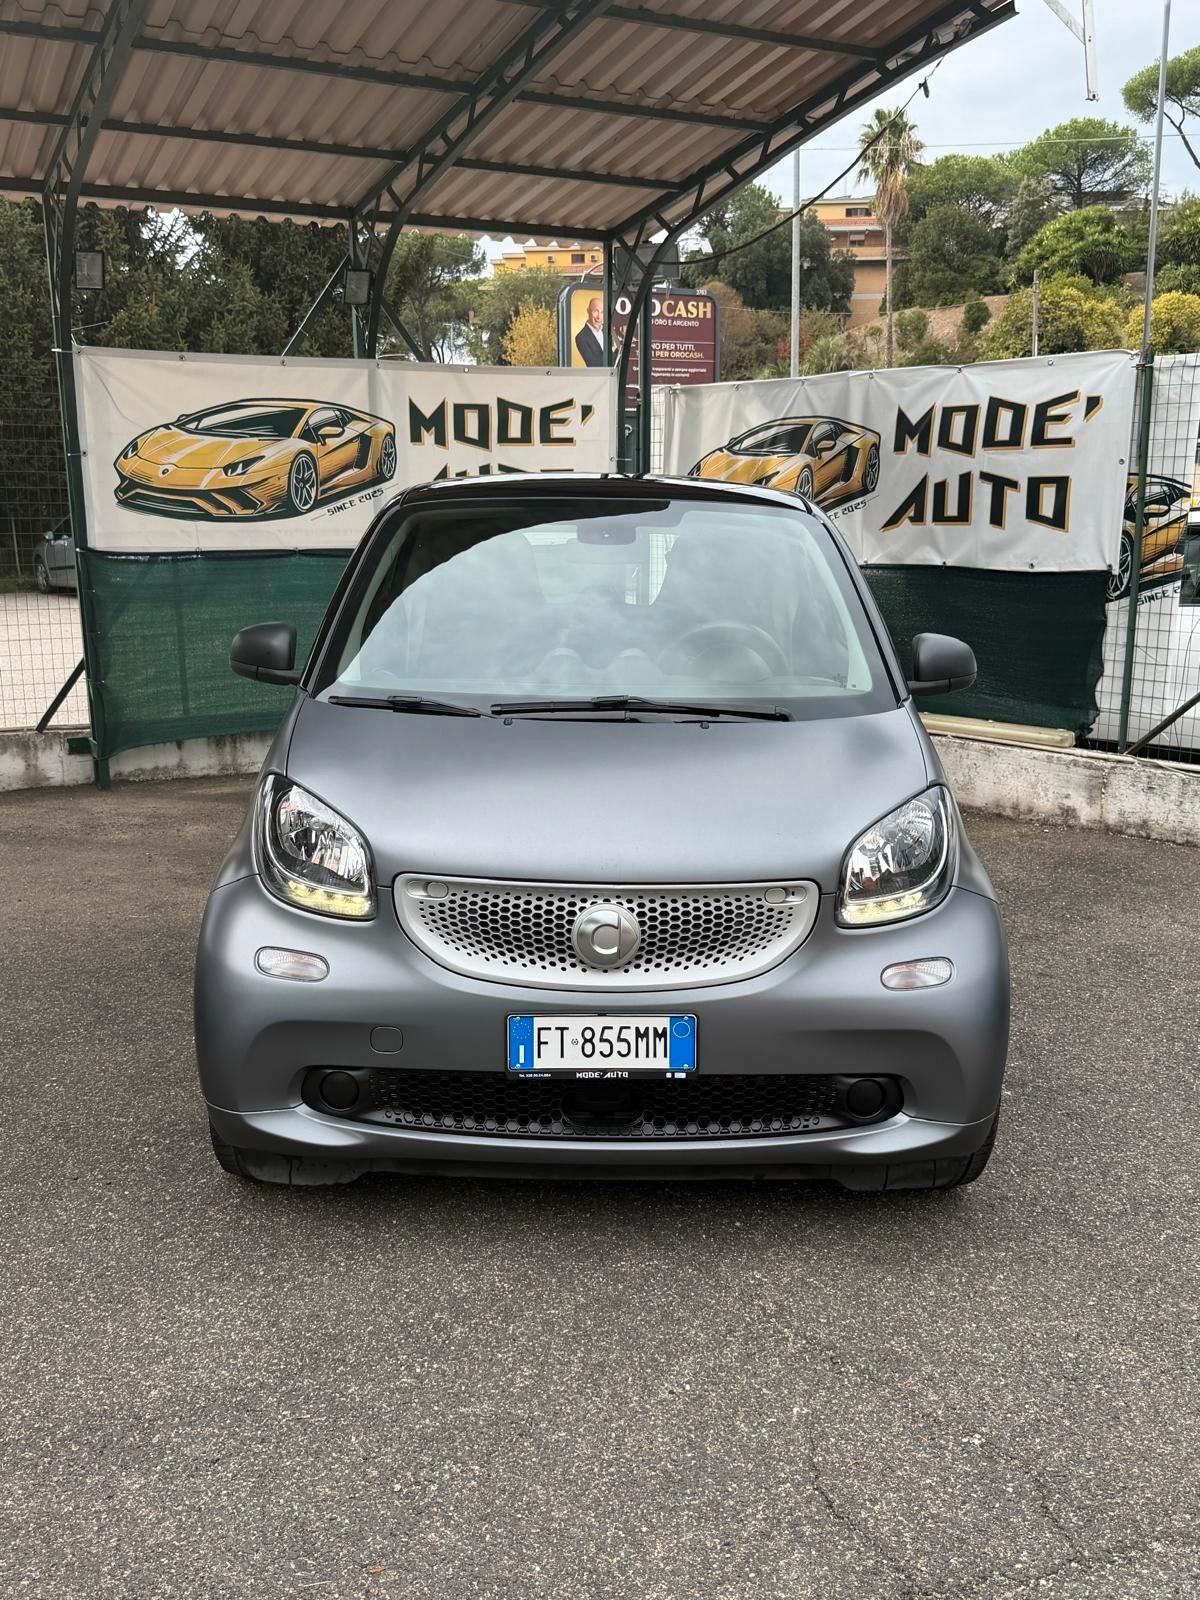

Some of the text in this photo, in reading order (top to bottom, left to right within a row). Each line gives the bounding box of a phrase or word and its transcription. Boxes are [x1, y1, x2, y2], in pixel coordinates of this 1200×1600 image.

[615, 297, 712, 318] OOCASH
[654, 318, 668, 326] ORO
[661, 343, 676, 351] PER
[327, 487, 384, 516] SINCE 2025
[841, 499, 867, 515] 2025
[880, 471, 1073, 533] AUTO
[1137, 589, 1169, 606] SINCE
[536, 1026, 668, 1059] FT 855MM
[603, 1071, 629, 1079] AUTO
